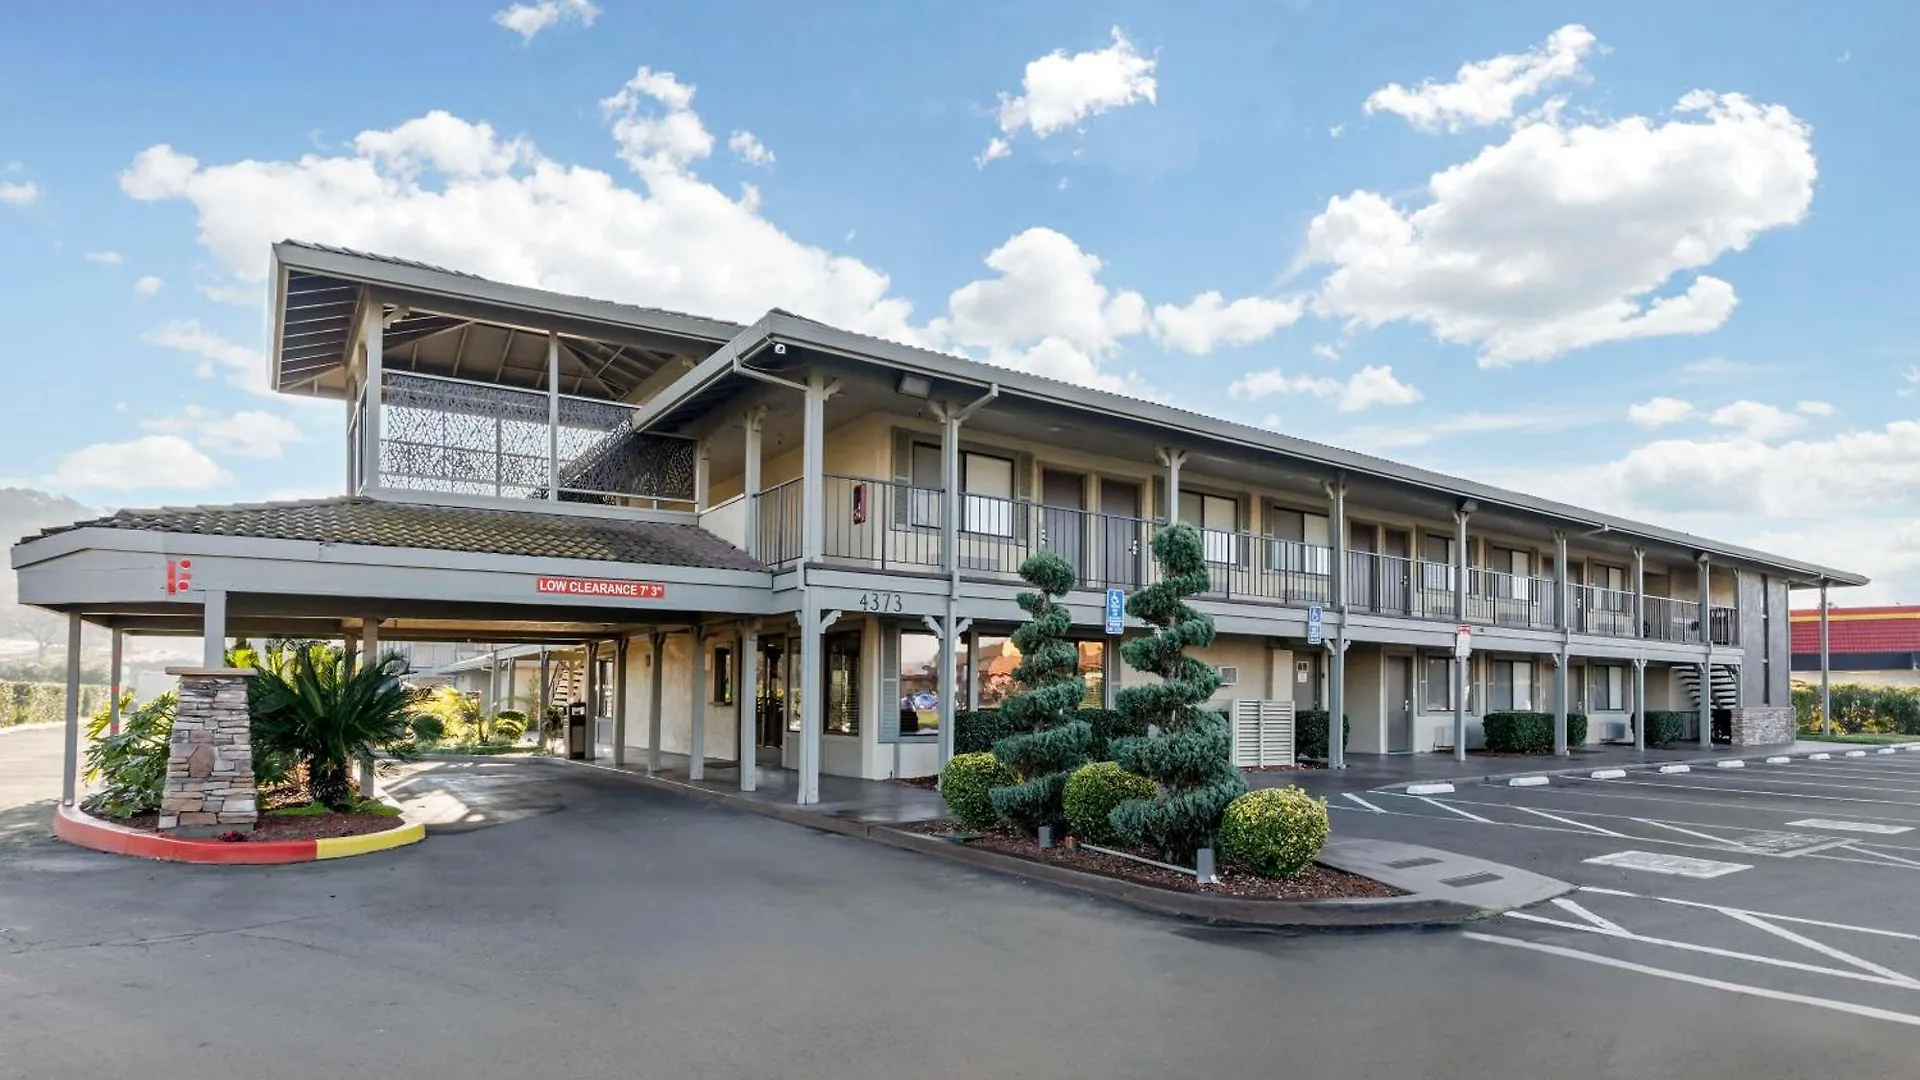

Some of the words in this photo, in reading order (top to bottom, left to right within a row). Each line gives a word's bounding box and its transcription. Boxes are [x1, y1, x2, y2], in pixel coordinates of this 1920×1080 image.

[539, 579, 567, 592] LOW
[569, 581, 637, 596] CLEARANCE
[640, 585, 649, 596] 7'
[859, 593, 902, 612] 4373
